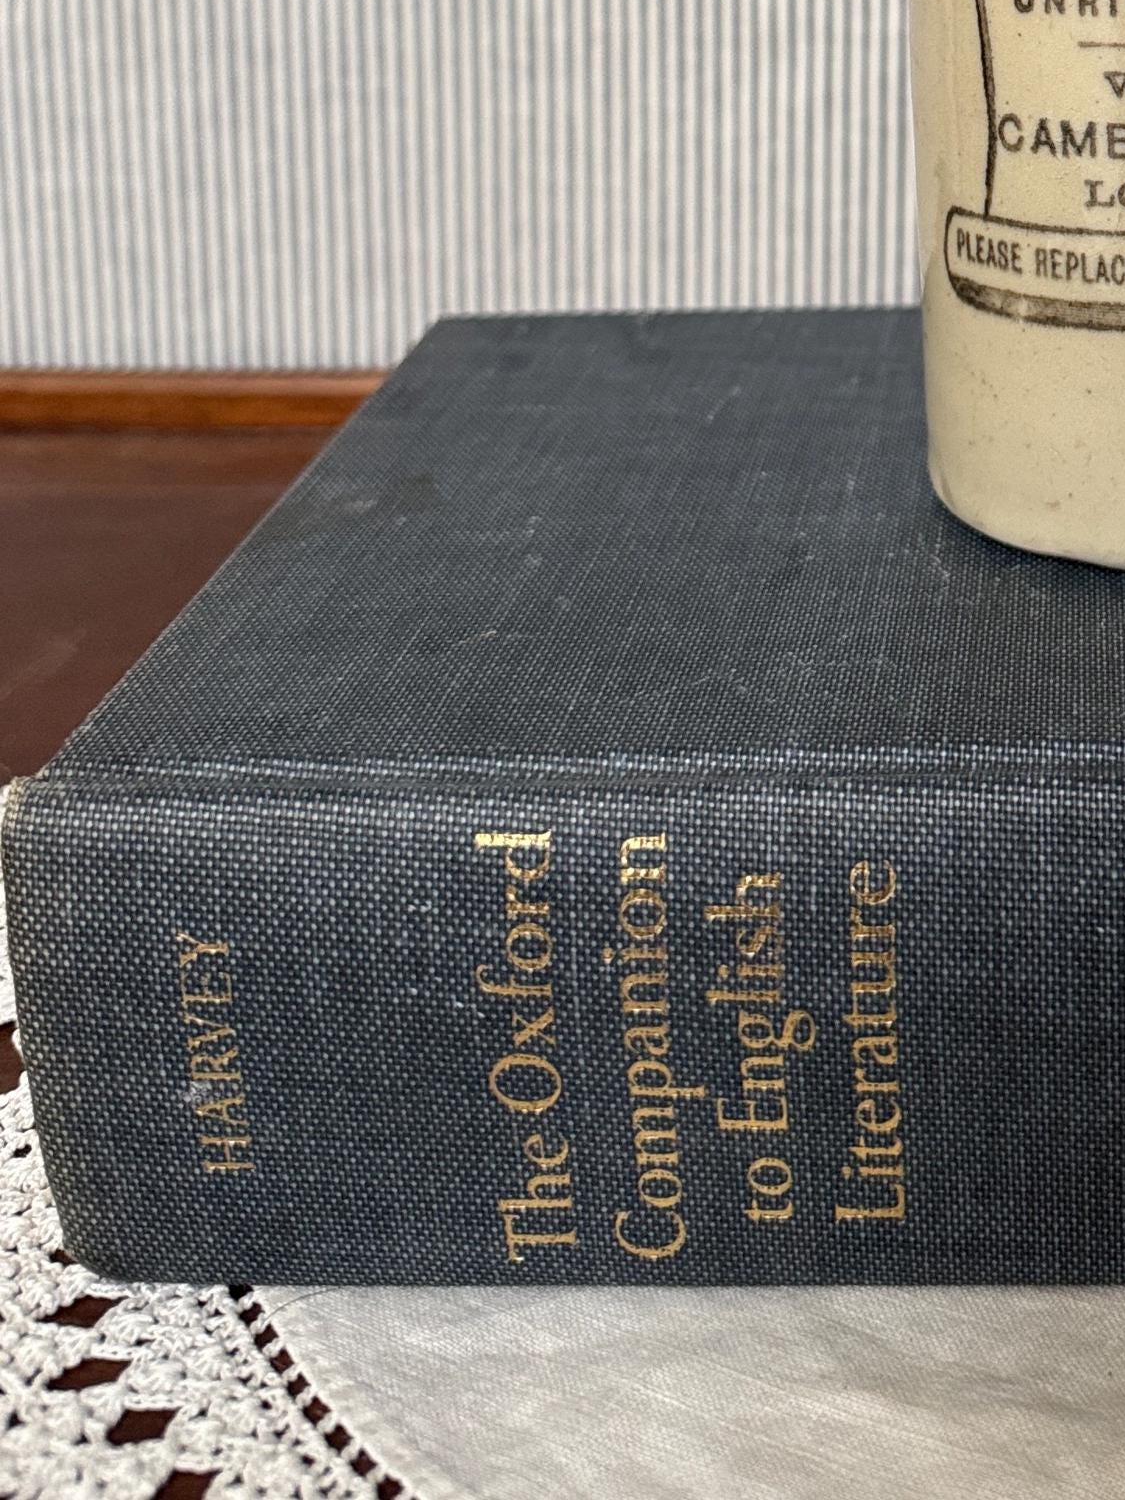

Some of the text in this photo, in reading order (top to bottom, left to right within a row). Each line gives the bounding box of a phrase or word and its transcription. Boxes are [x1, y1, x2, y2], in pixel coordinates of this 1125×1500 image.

[956, 230, 1023, 275] PLEASE
[177, 931, 255, 1174] HARVEY
[473, 828, 578, 1263] The Oxford
[600, 830, 705, 1261] Companion
[703, 871, 816, 1223] to English
[834, 858, 906, 1224] Literature
